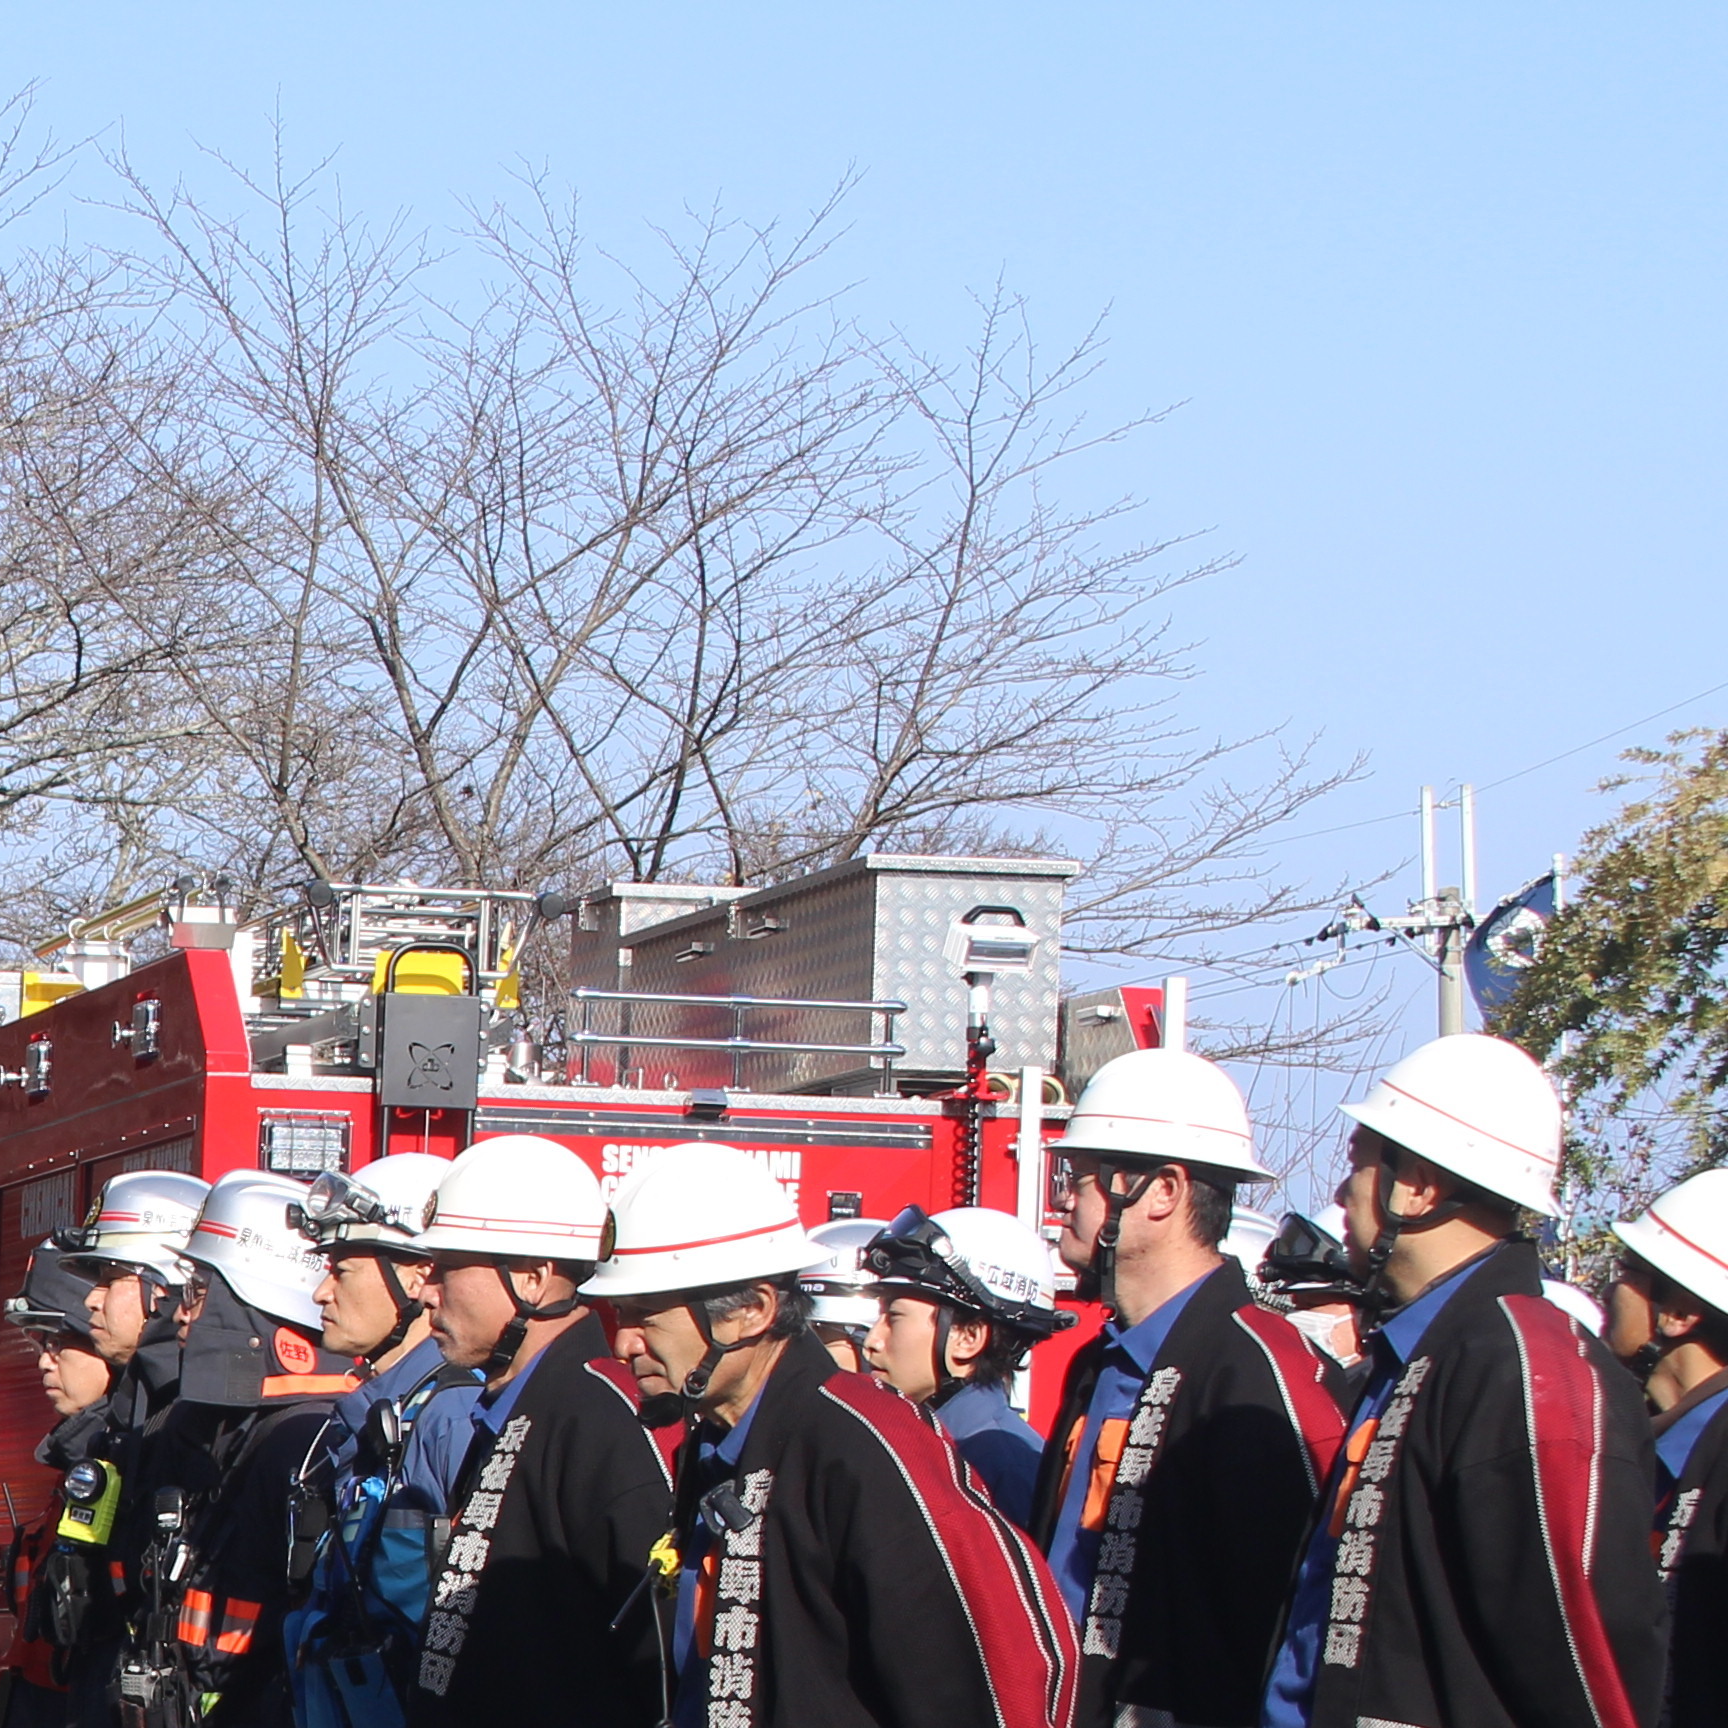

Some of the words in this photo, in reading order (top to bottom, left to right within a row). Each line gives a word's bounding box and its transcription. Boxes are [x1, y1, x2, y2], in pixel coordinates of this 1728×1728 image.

[279, 1339, 310, 1363] 佐野
[418, 1414, 532, 1697] 泉佐野市消防団
[1082, 1366, 1182, 1660] 泉佐野市消防団
[1323, 1355, 1432, 1669] 泉佐野市消防団
